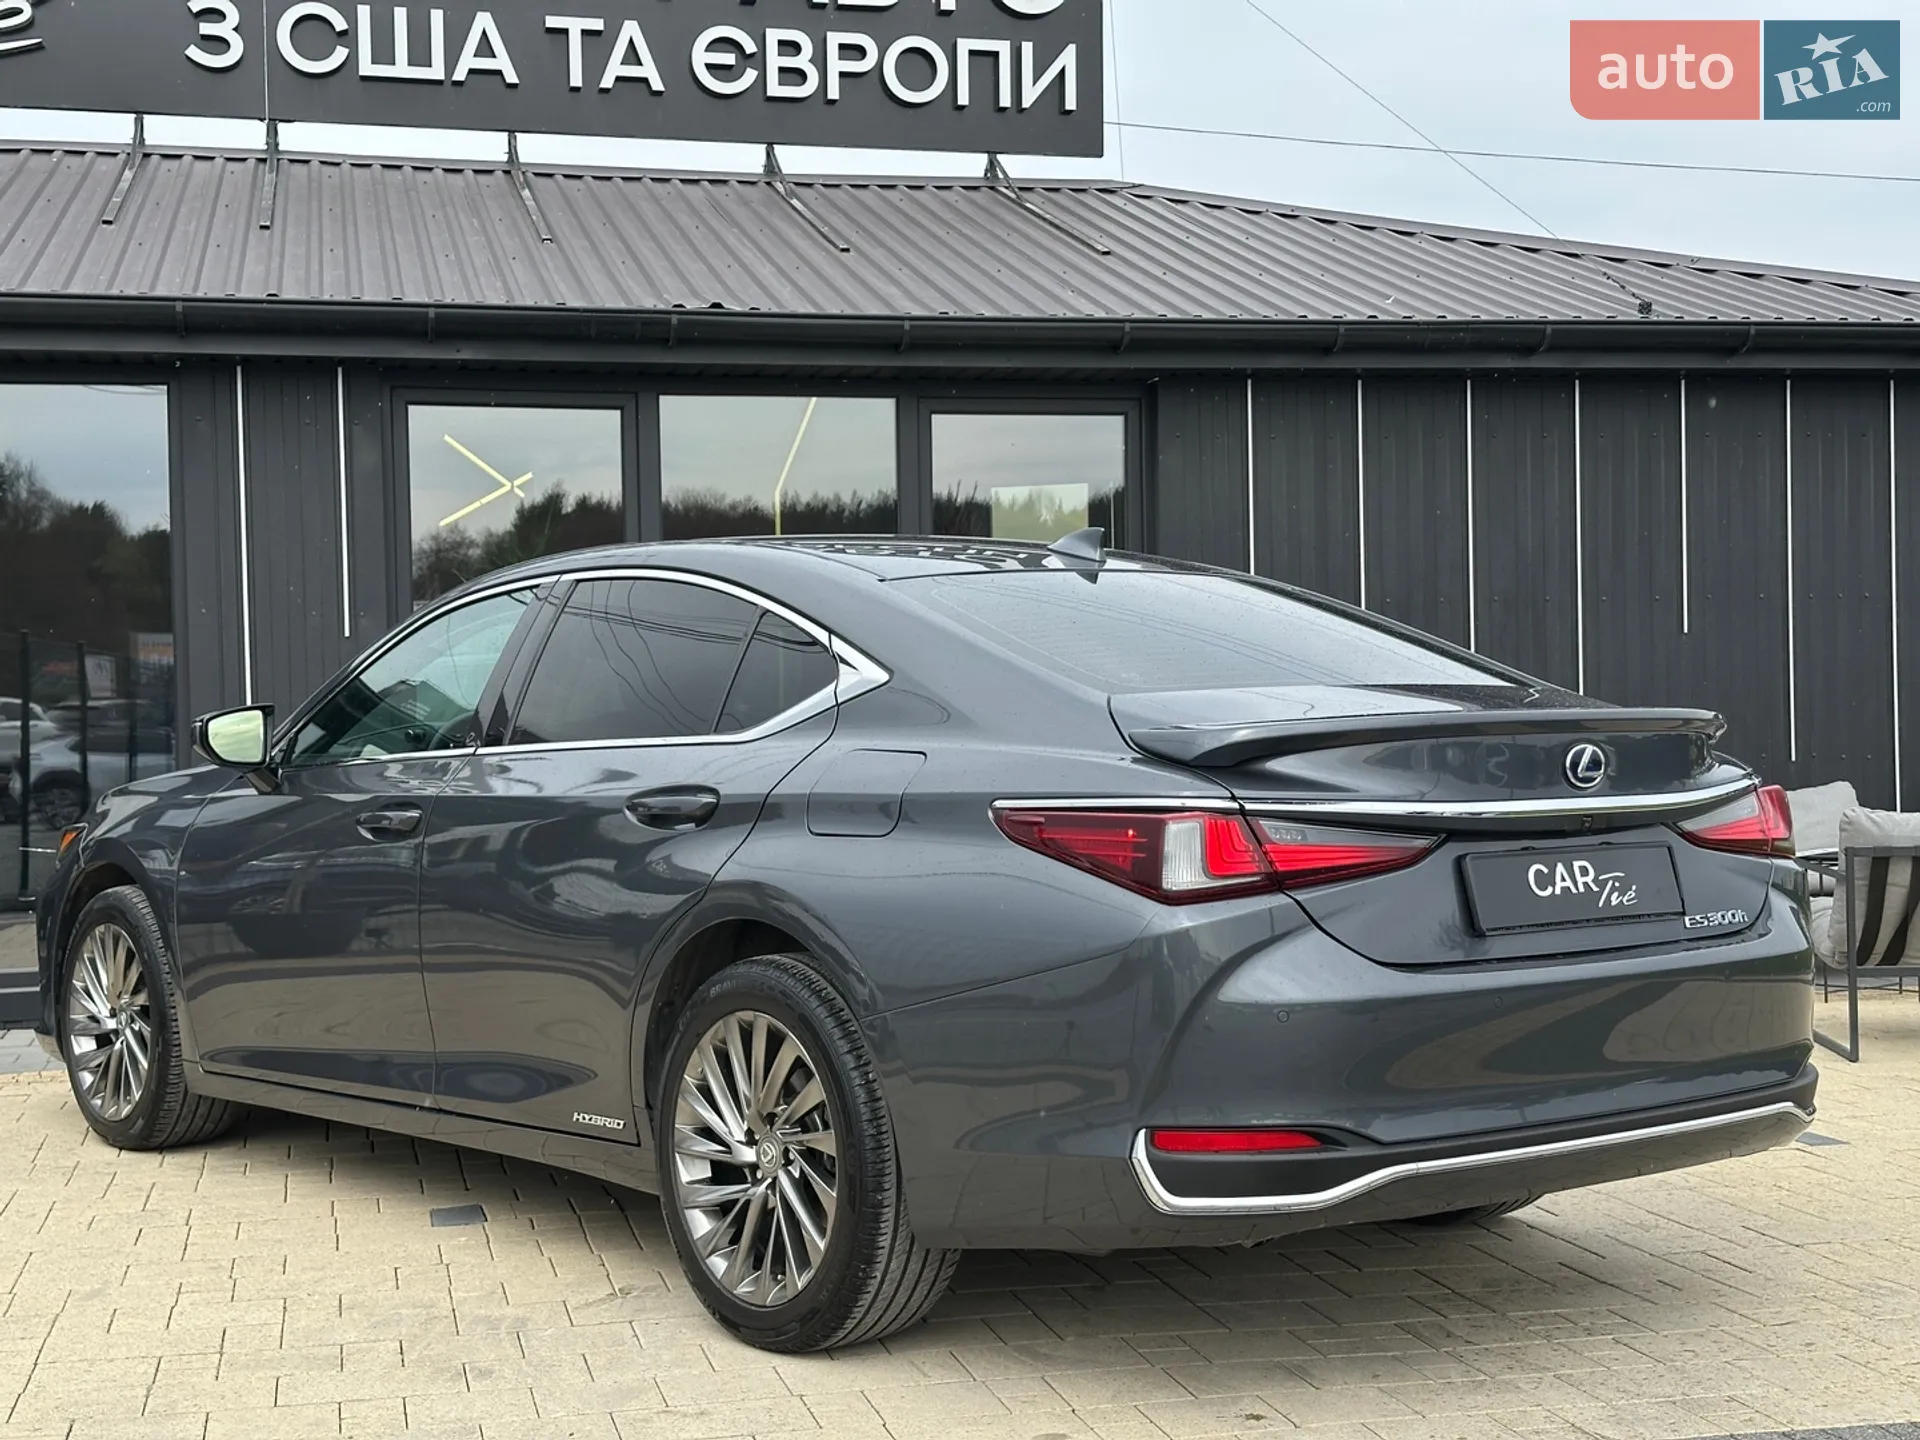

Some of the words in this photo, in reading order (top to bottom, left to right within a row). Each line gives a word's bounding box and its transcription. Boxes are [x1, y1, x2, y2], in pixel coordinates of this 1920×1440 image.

[184, 0, 245, 69] З
[275, 2, 520, 88] США
[545, 15, 665, 93] ТА
[690, 25, 1078, 112] ЄВРОПИ
[1528, 860, 1599, 897] CAR
[573, 1112, 625, 1130] HYBRID
